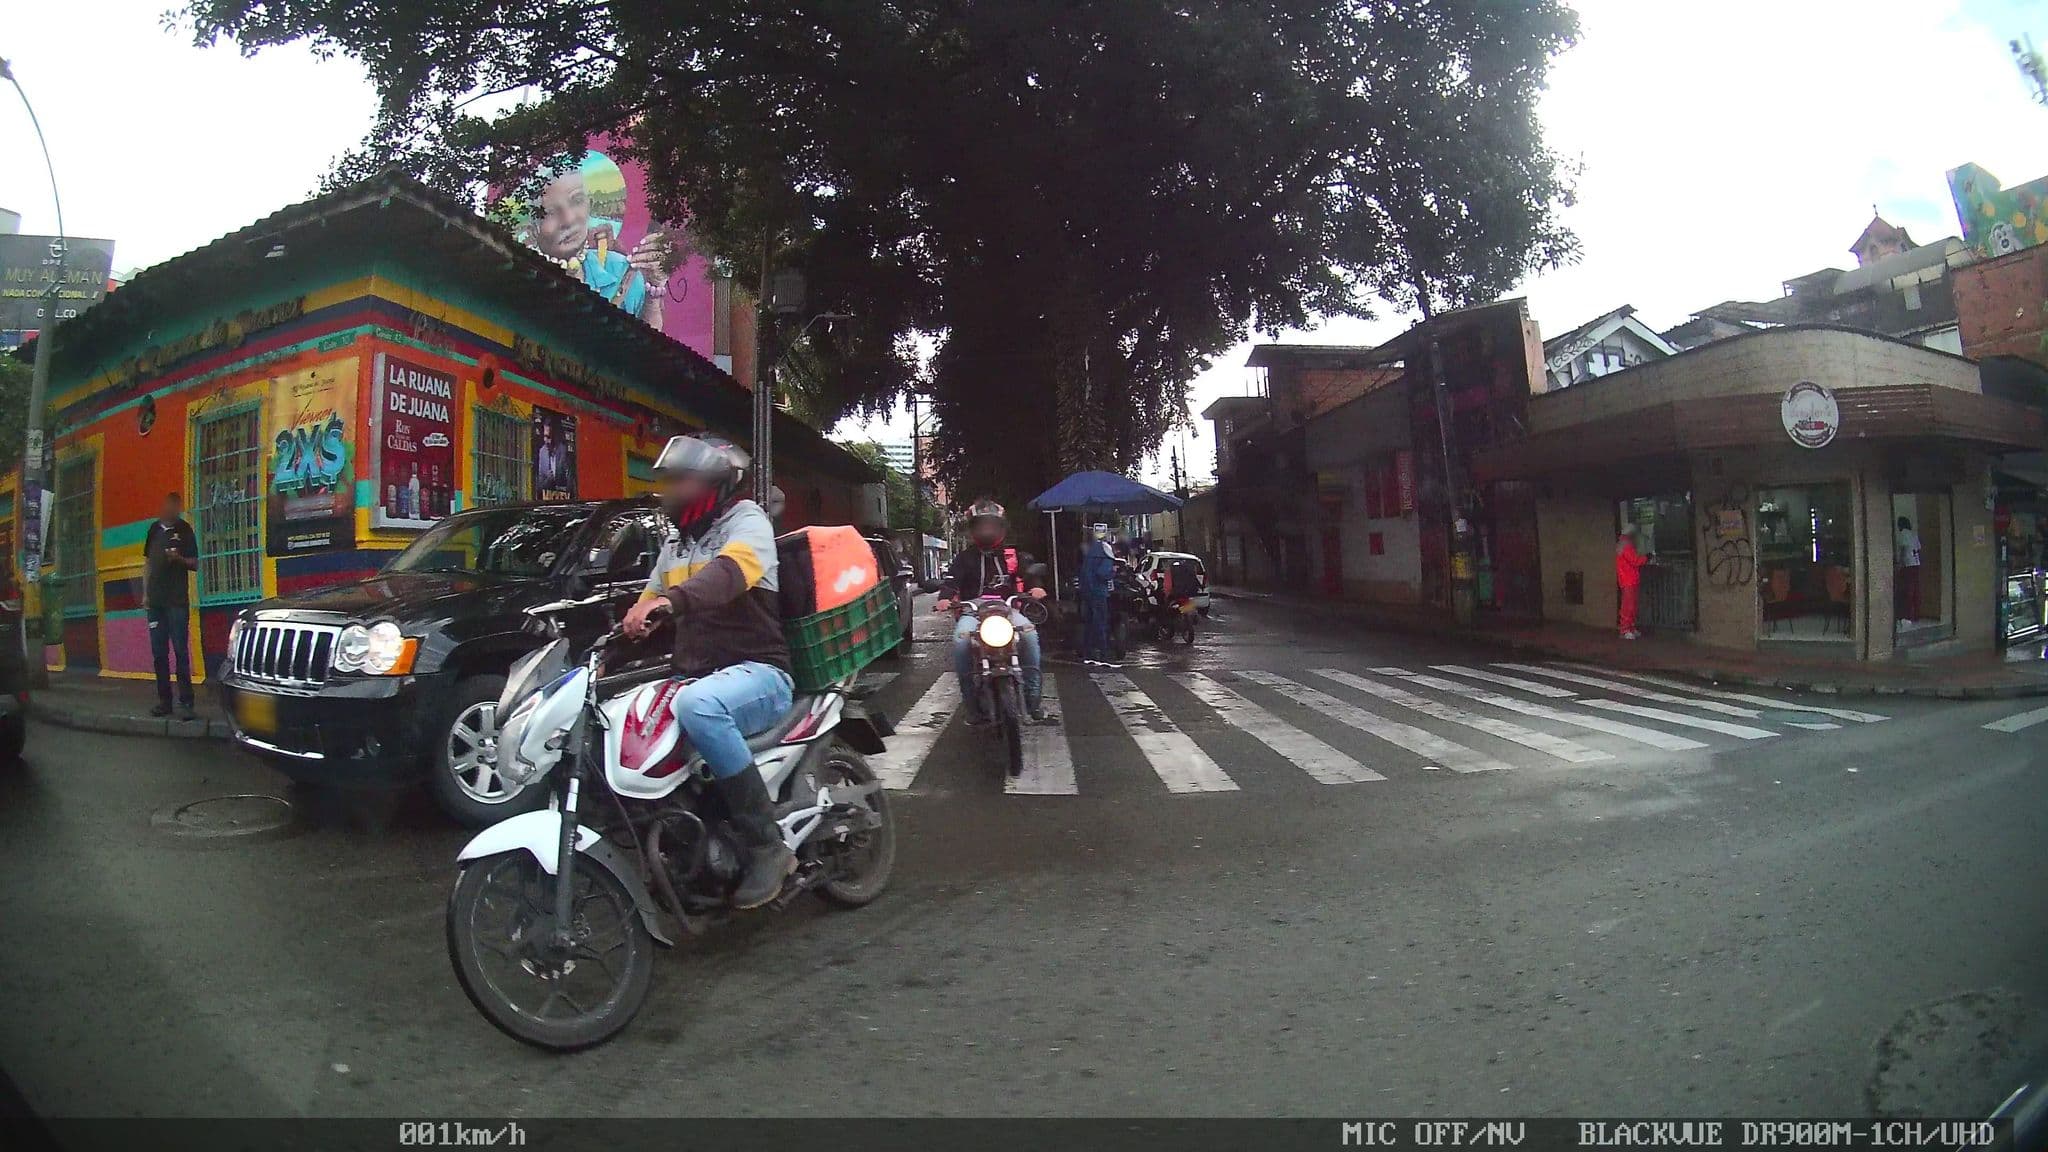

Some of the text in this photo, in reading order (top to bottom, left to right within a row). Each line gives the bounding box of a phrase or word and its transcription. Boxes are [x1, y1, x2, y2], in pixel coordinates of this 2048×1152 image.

[6, 267, 33, 282] MUY
[390, 364, 451, 400] LA RUANA
[390, 391, 449, 423] DE JUANA
